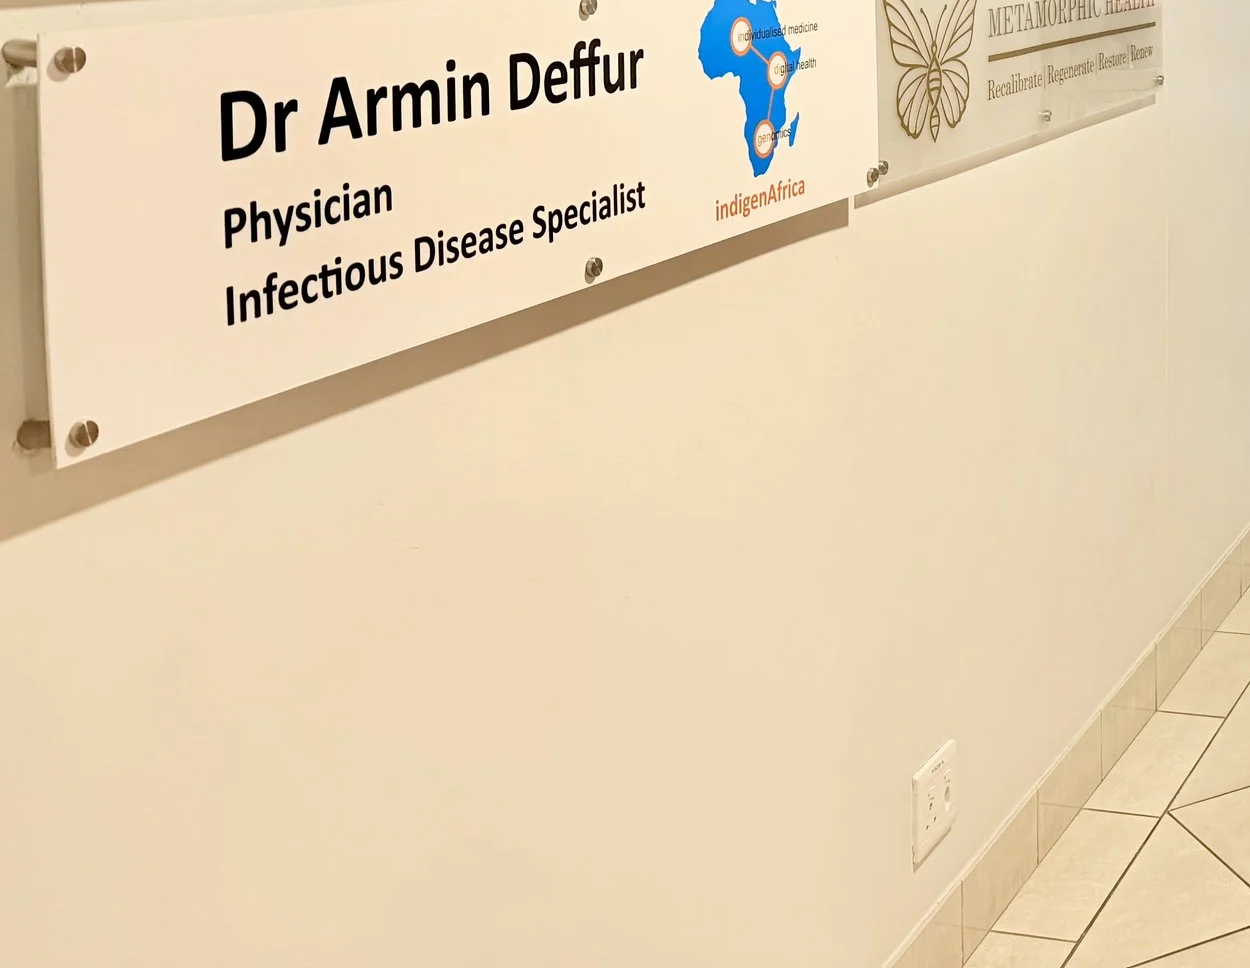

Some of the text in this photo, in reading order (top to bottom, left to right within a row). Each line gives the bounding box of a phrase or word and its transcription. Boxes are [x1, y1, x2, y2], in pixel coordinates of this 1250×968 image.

[737, 21, 818, 42] individualised medicine
[774, 56, 817, 77] digital health
[987, 44, 1154, 100] Recalibrate Regenerate Restore Renew
[220, 38, 644, 162] Dr Armin Deffur
[757, 127, 792, 146] genomics
[223, 182, 393, 249] Physician
[715, 179, 806, 222] indigenAfrica
[226, 181, 646, 326] Infectious Disease Specialist
